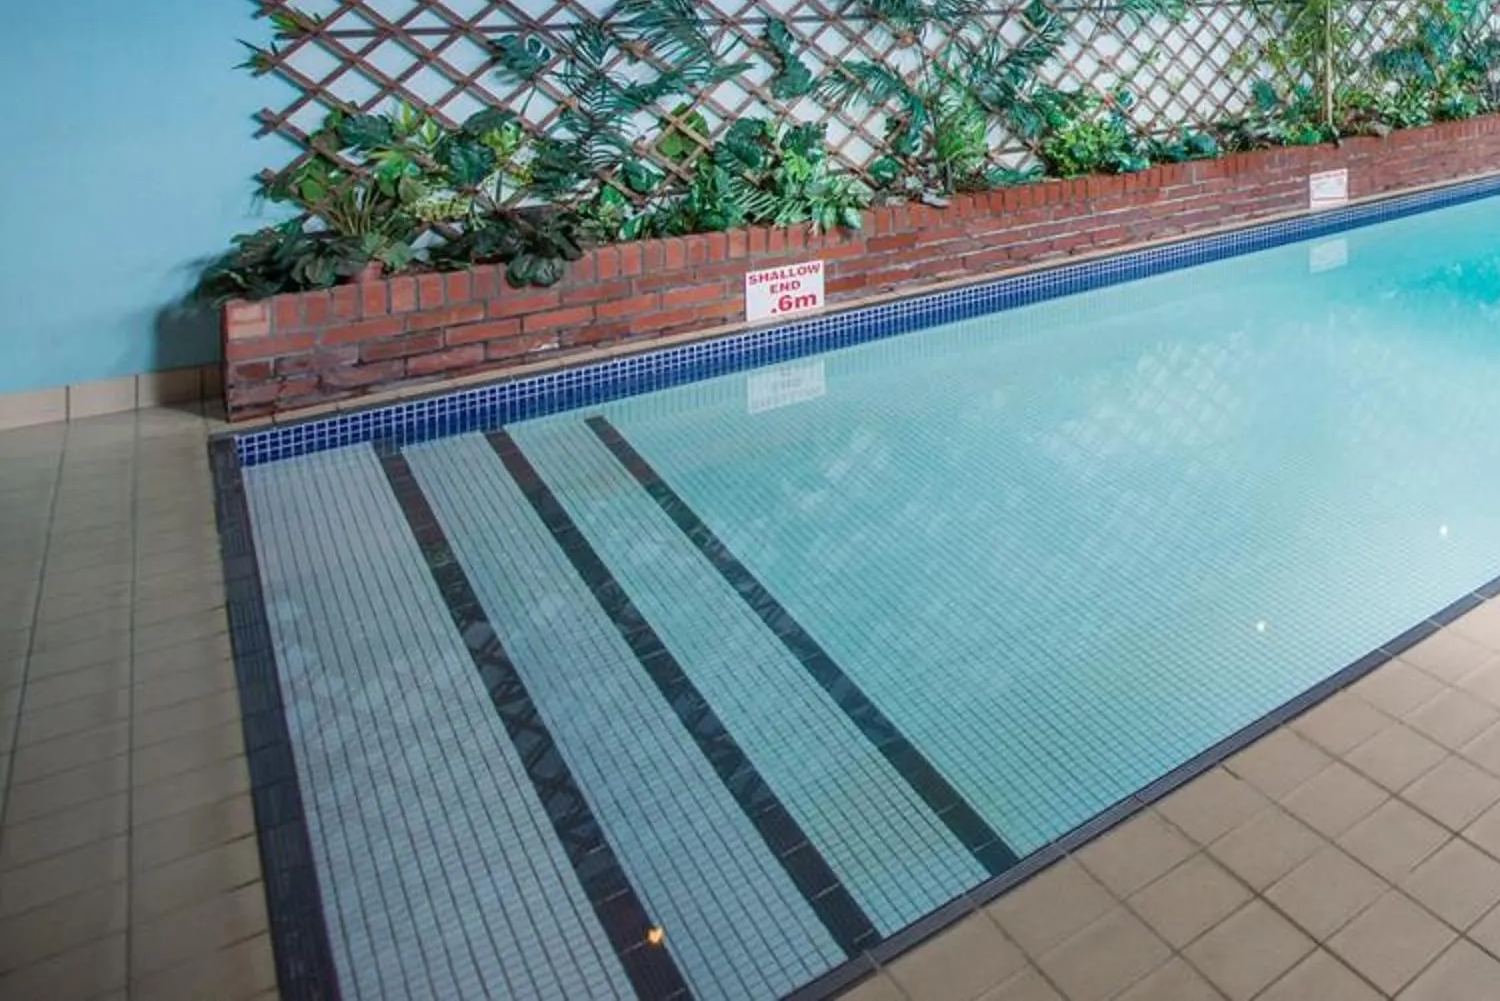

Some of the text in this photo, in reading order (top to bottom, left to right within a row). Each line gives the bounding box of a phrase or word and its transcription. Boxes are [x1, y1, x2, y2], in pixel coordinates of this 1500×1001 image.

[749, 263, 820, 285] SHALLOW
[770, 280, 801, 294] END
[771, 293, 817, 314] .6m
